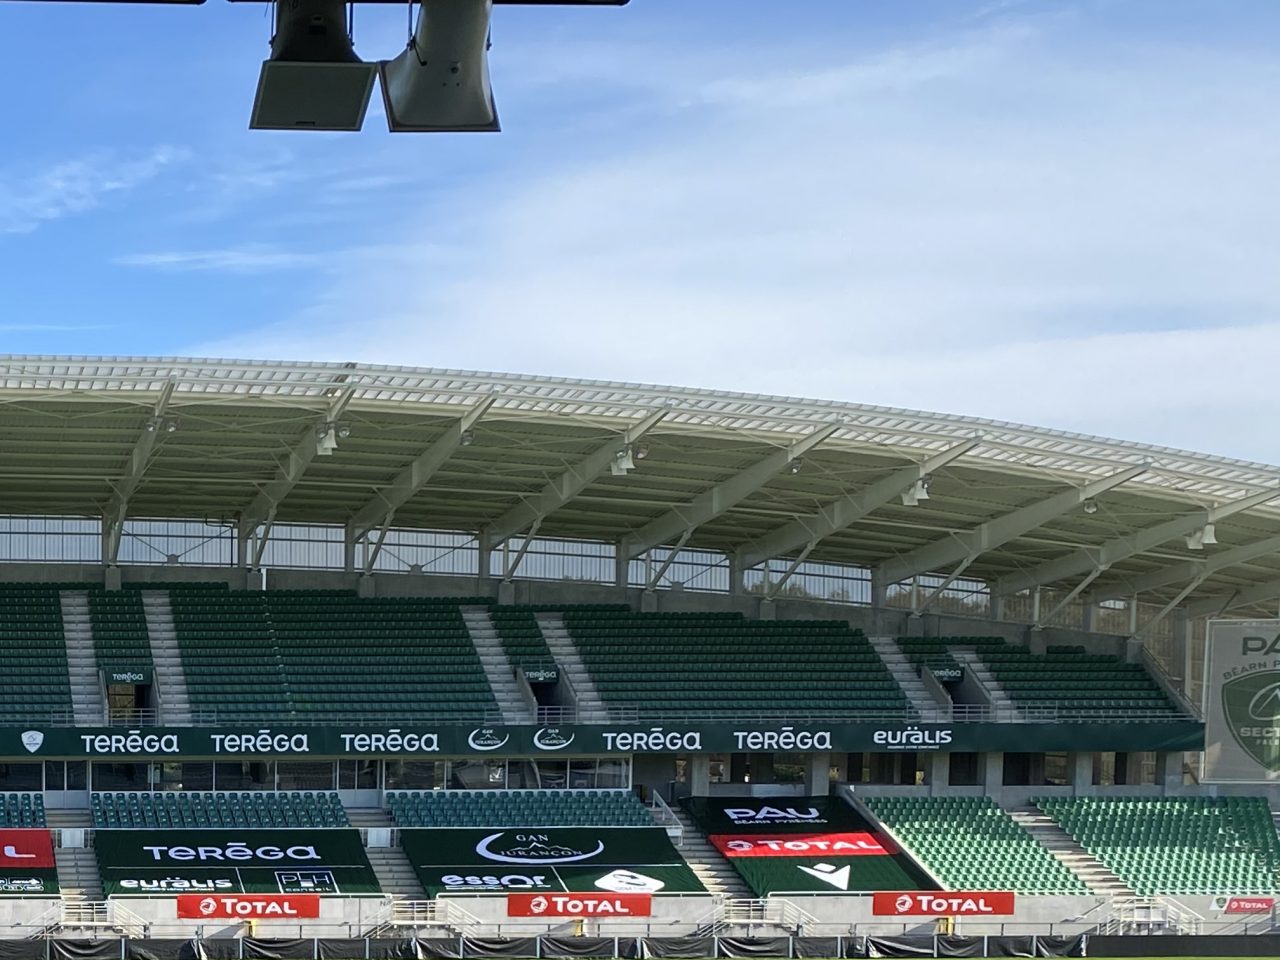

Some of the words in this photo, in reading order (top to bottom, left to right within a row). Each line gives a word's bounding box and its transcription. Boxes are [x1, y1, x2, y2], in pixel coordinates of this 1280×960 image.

[723, 806, 820, 820] PAU
[516, 834, 549, 842] GAN
[757, 840, 883, 851] TOTAL
[441, 875, 546, 887] essor
[221, 899, 297, 914] TOTAL
[552, 897, 629, 913] TOTAL
[917, 896, 993, 912] TOTAL
